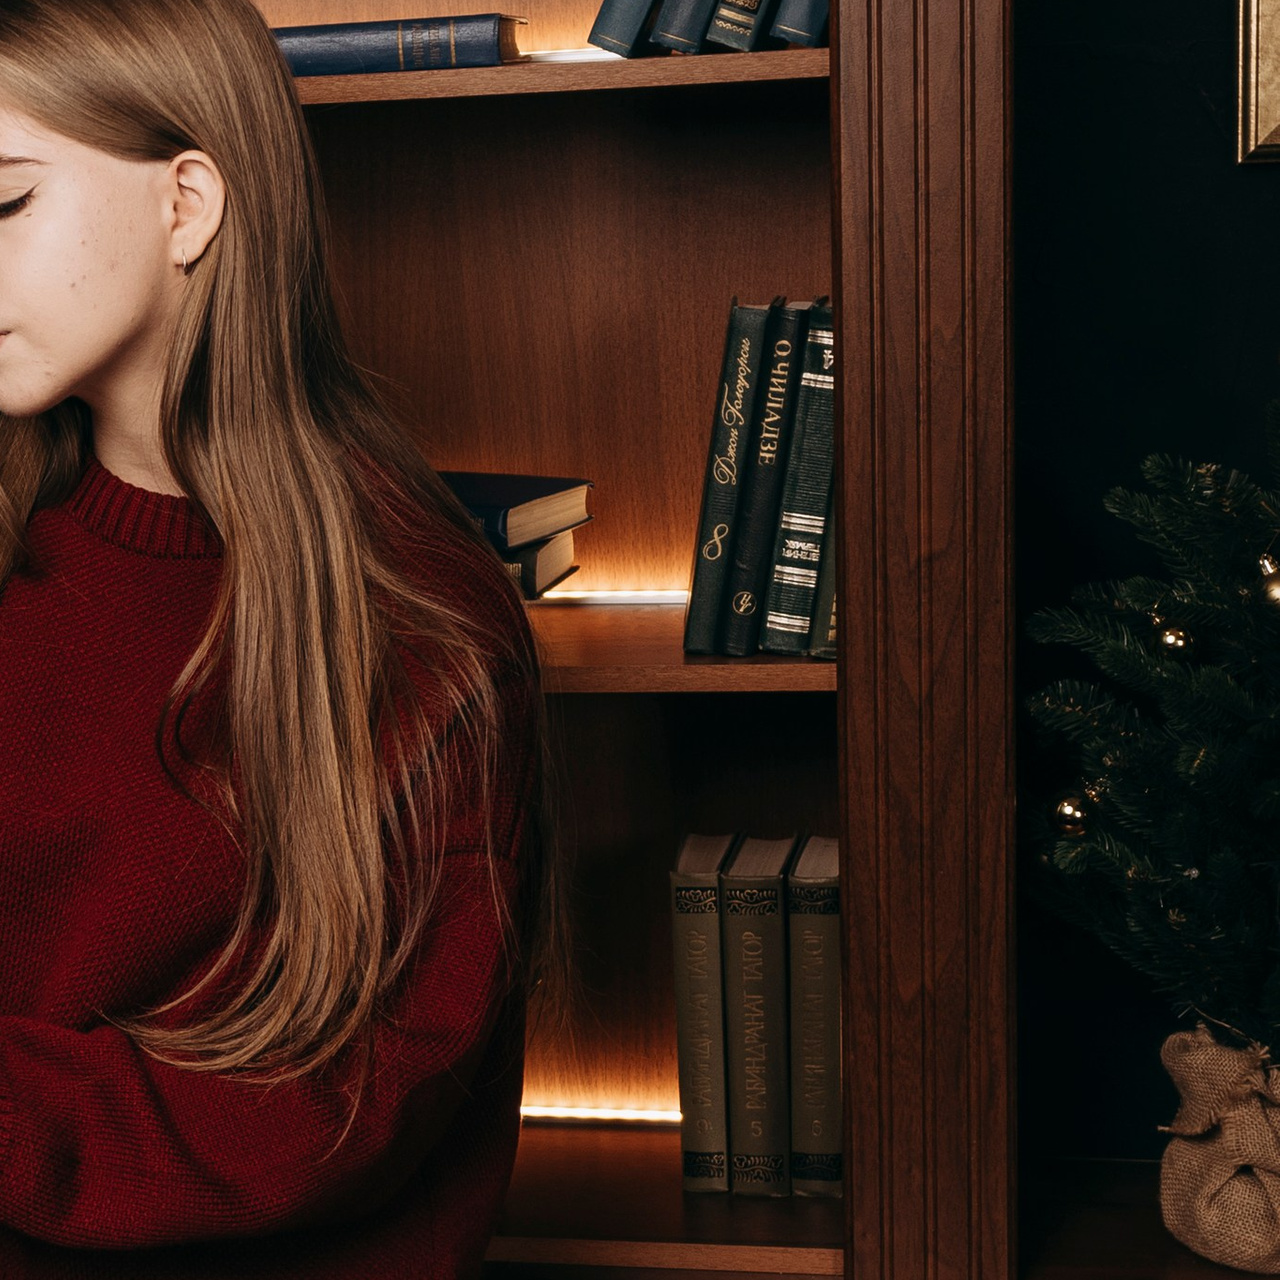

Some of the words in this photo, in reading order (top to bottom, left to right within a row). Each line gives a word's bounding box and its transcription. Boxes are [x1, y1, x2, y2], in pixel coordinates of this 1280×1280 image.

[718, 335, 755, 428] Голсуорси
[710, 425, 743, 486] Джон
[702, 522, 730, 561] 8
[738, 930, 766, 983] ТАГОР
[736, 989, 772, 1109] РАБИНДРАНАТ
[750, 1120, 763, 1137] 5
